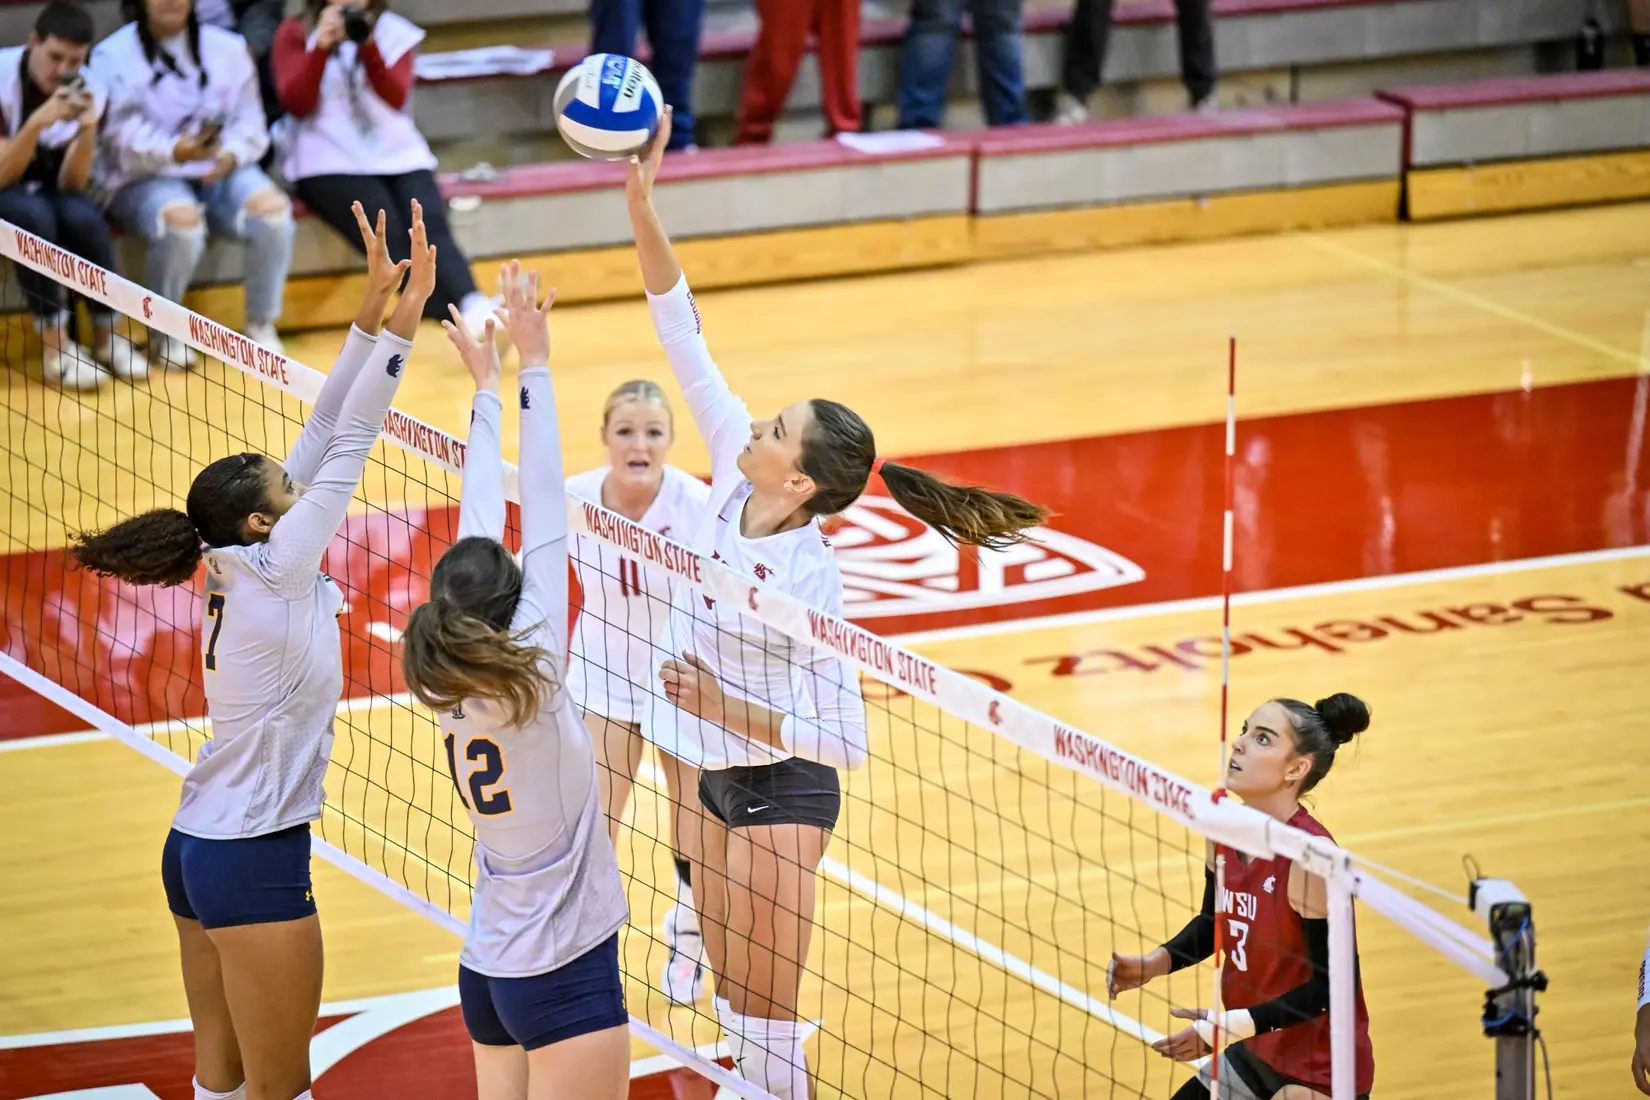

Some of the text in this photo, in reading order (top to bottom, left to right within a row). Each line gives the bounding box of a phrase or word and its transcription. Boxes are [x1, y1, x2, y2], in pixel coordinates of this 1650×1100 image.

[15, 230, 108, 296] WASHINGTON STATE
[189, 314, 289, 386] WASHINGTON STATE
[583, 502, 702, 584] WASHINGTON STATE
[619, 555, 641, 598] 11
[205, 591, 226, 673] 7
[807, 608, 894, 676] WASHINGTON
[897, 650, 937, 695] STATE
[444, 732, 513, 818] 12
[1053, 724, 1195, 820] WASHINGTON STATE
[1221, 886, 1257, 921] WSU
[1227, 918, 1249, 972] 3
